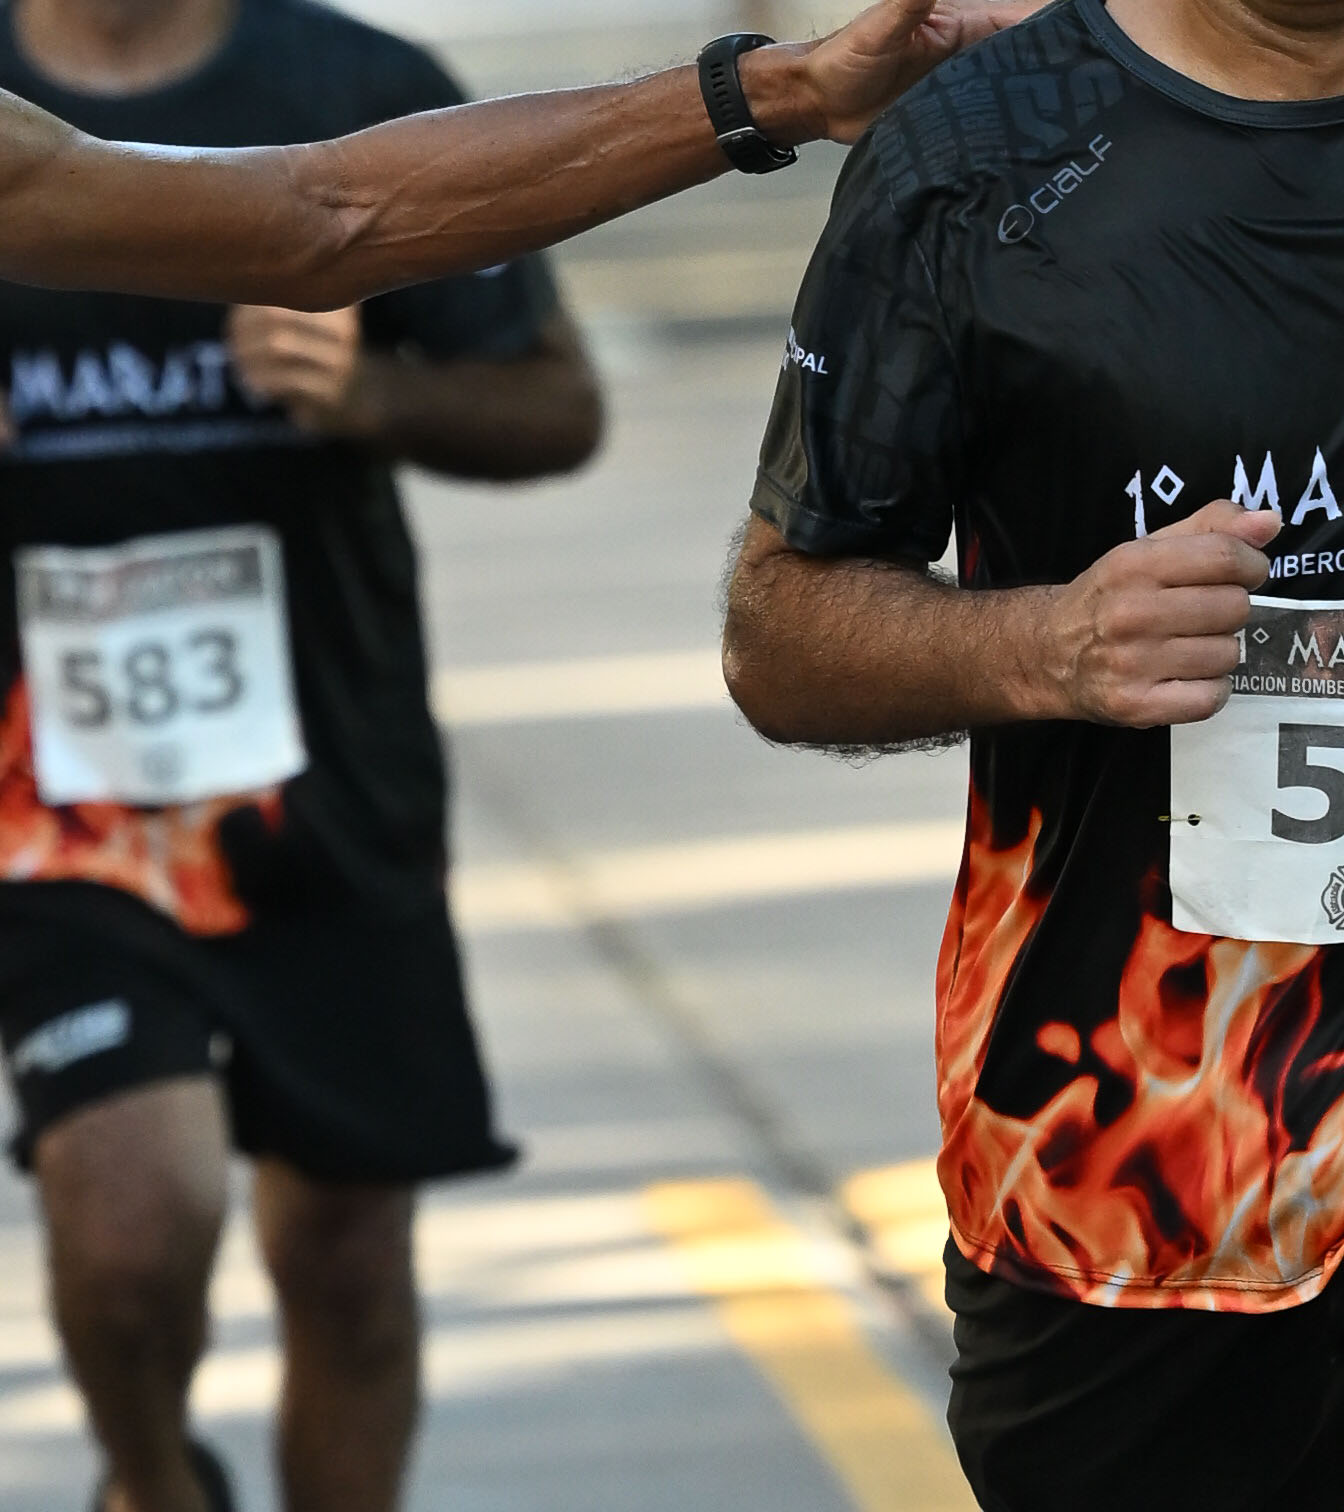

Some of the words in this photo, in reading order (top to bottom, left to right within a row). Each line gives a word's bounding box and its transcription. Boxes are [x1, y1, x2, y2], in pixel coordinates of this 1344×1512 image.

[10, 340, 242, 424] MARAT
[61, 627, 243, 730] 583
[1271, 722, 1344, 845] 5
